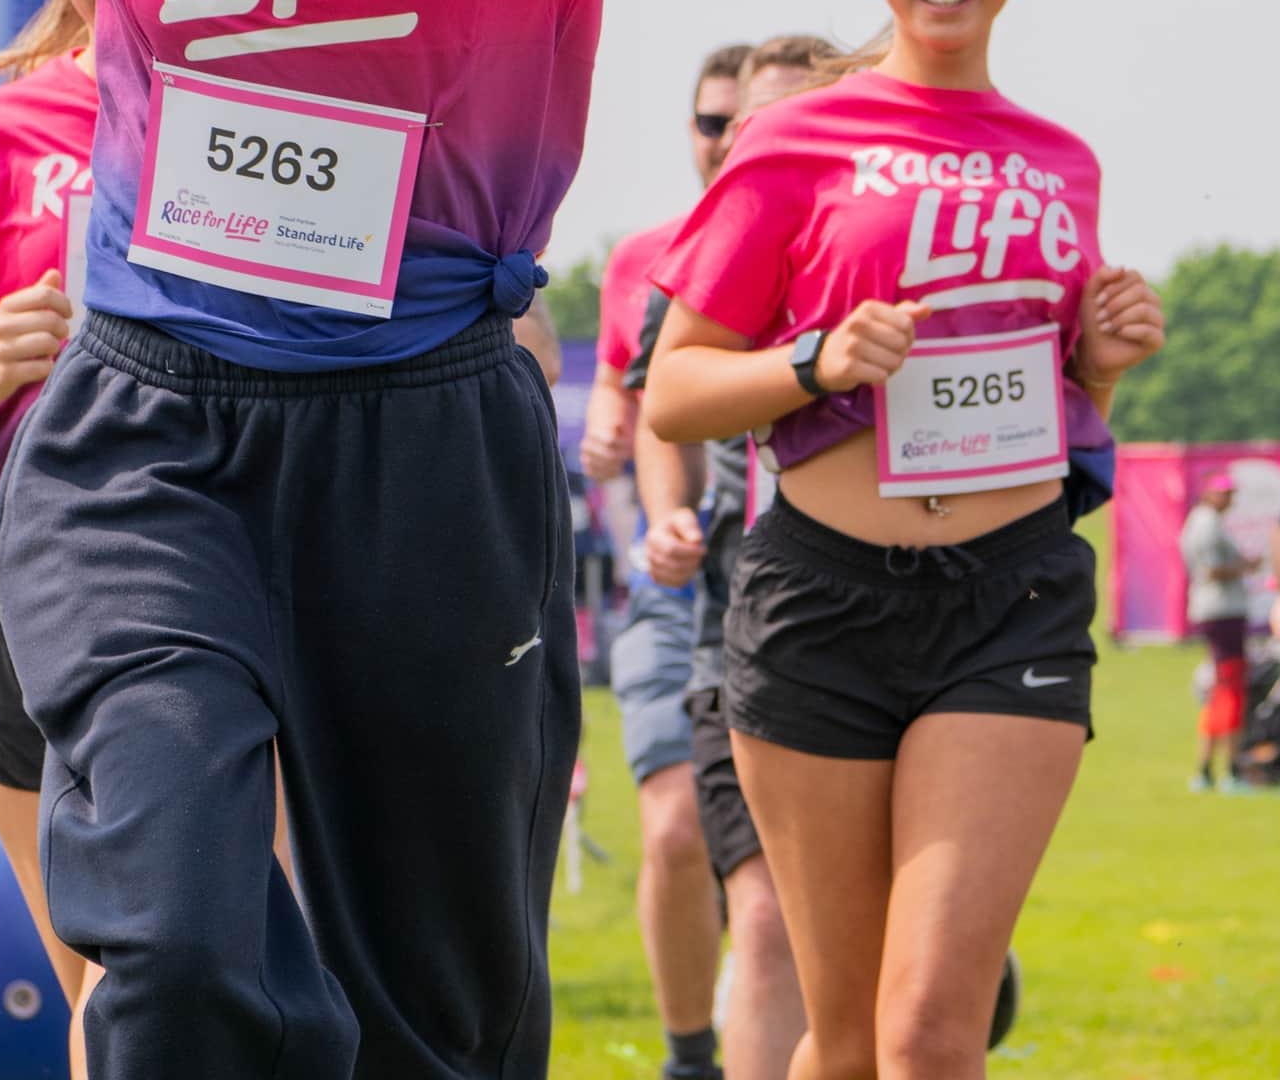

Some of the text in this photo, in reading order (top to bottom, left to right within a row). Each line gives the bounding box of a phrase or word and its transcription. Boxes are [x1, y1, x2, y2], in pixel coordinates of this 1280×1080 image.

[207, 127, 339, 192] 5263
[851, 146, 1065, 197] Race for
[161, 200, 201, 225] Race
[202, 211, 226, 229] for
[224, 212, 269, 236] Life
[898, 187, 1082, 288] Life
[276, 225, 337, 246] Standard
[338, 236, 365, 252] Life
[932, 370, 1025, 409] 5265
[901, 441, 938, 460] Race
